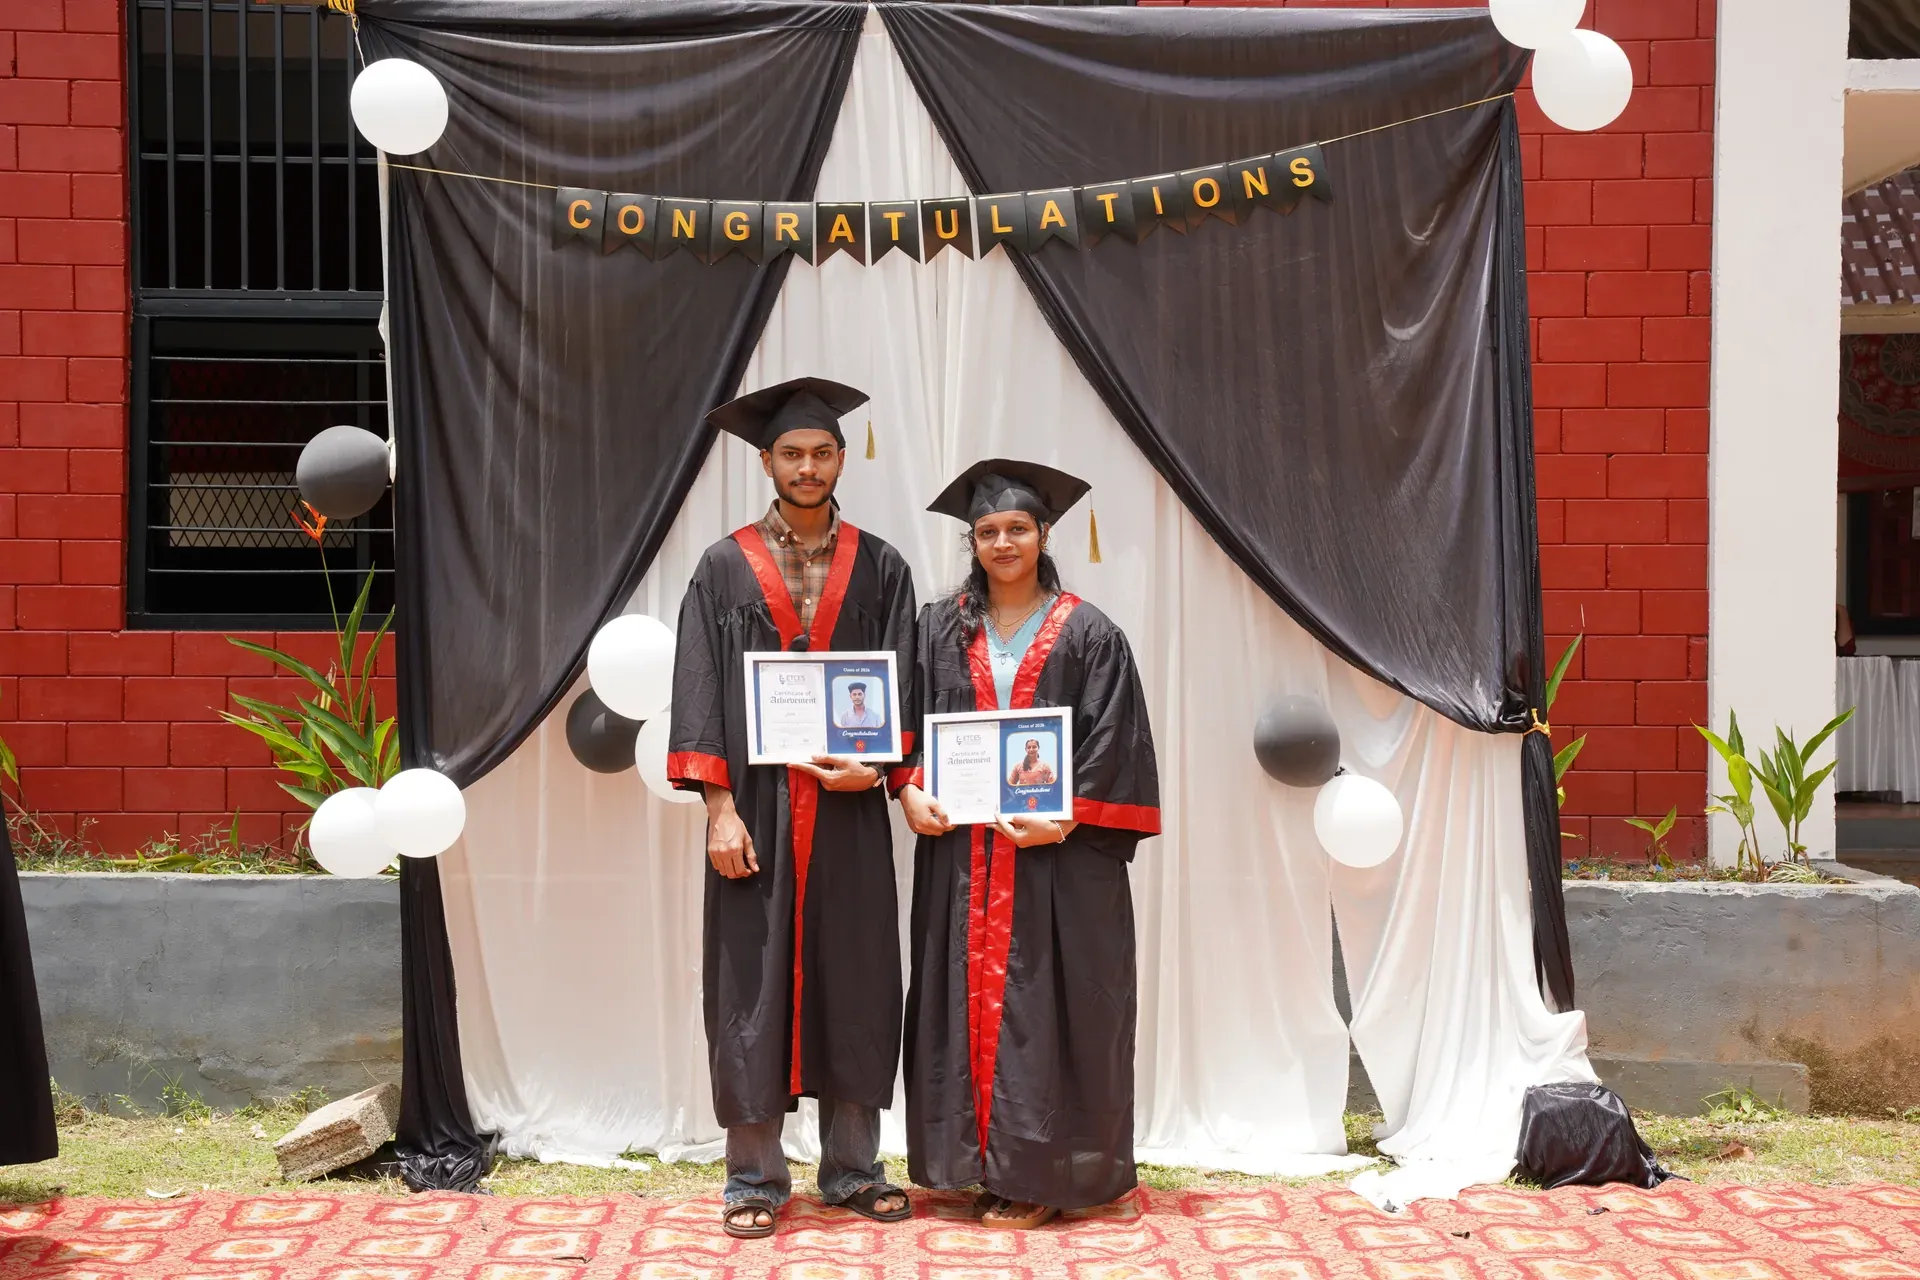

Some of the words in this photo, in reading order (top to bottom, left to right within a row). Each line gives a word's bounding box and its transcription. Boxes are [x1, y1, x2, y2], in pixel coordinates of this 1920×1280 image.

[569, 156, 1315, 243] CONGRATULATIONS
[770, 696, 816, 704] Achievement
[948, 757, 991, 765] Achievement
